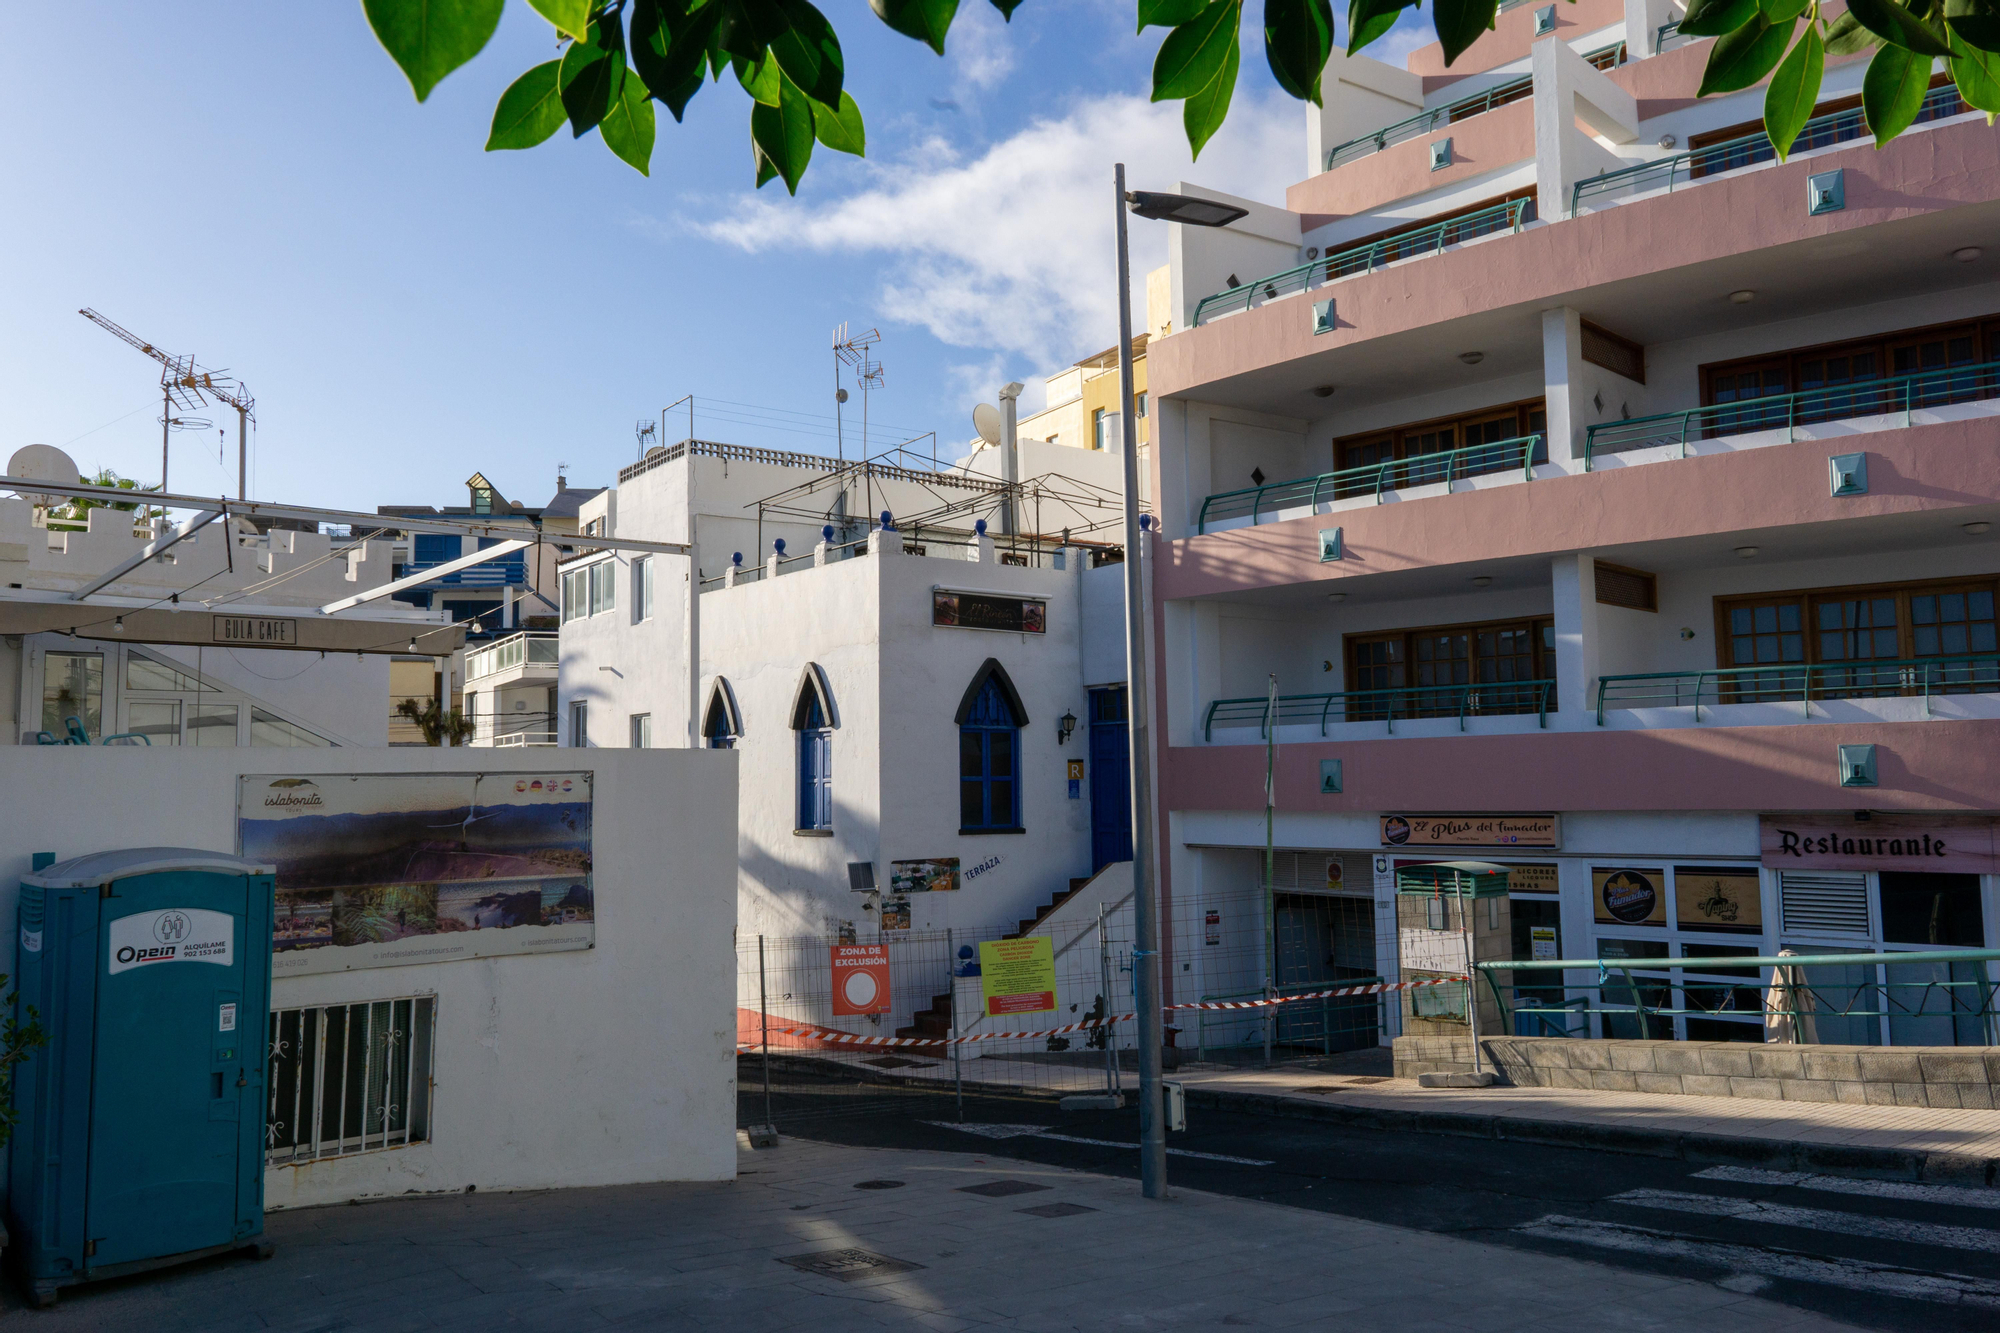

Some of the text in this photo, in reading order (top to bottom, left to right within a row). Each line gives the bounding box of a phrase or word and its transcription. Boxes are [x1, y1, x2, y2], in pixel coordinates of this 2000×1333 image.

[225, 619, 253, 640] GULA
[1071, 764, 1081, 778] R
[264, 792, 323, 807] islabonita
[1413, 820, 1430, 832] El
[1430, 820, 1473, 840] Plus
[1476, 822, 1493, 832] del
[1776, 828, 1947, 858] Restaurante
[965, 856, 1001, 881] TERRAZA
[1608, 889, 1652, 908] Fumador
[1698, 898, 1738, 917] Vaping
[1721, 914, 1738, 922] SHOP
[183, 941, 226, 951] ALQUÍLAME
[527, 936, 588, 947] islabonitatours.com
[116, 946, 177, 964] Opein
[183, 950, 197, 958] 902
[199, 949, 212, 957] 153
[380, 946, 464, 959] info@islabonitatours.com
[839, 946, 881, 956] ZONA DE
[835, 956, 887, 967] EXCLUSIÓN
